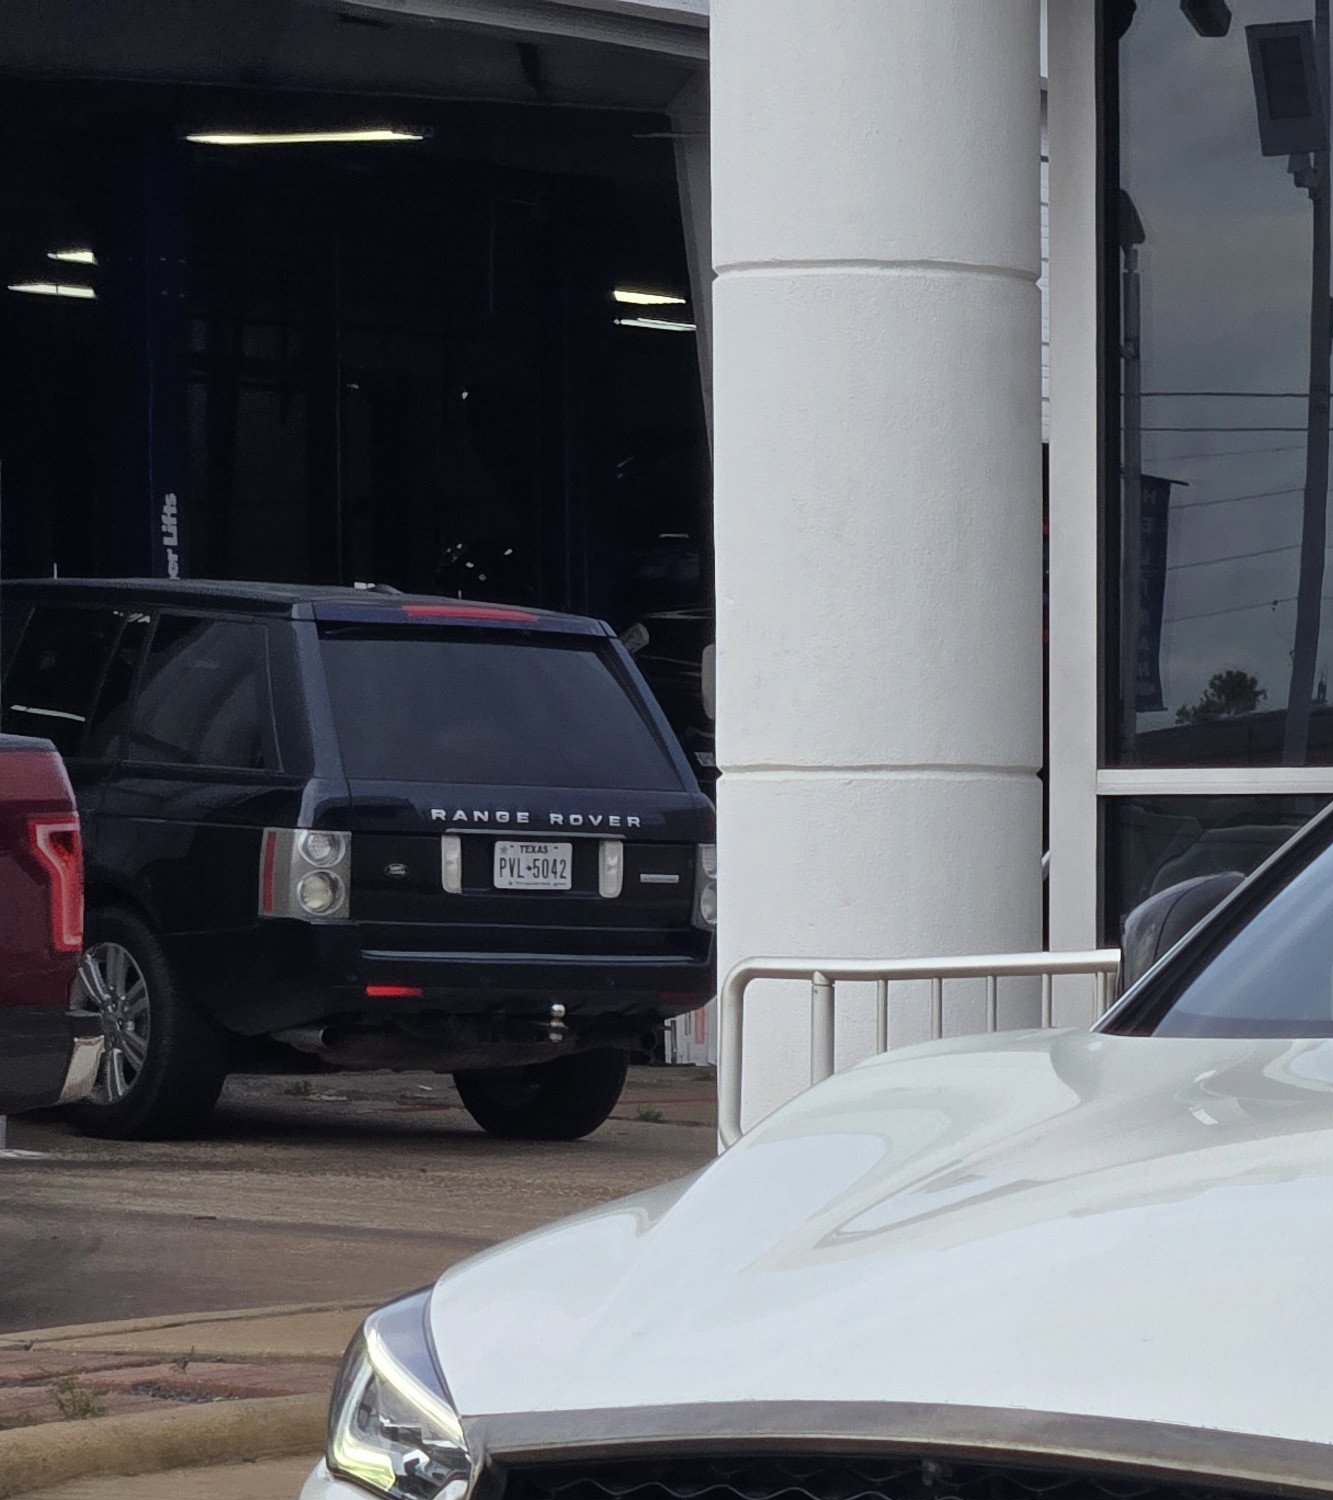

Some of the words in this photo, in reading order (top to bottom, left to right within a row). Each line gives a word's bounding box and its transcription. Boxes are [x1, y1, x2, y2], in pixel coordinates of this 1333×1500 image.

[430, 808, 530, 823] RANGE
[550, 813, 641, 828] ROVER
[520, 845, 548, 854] TEXAS
